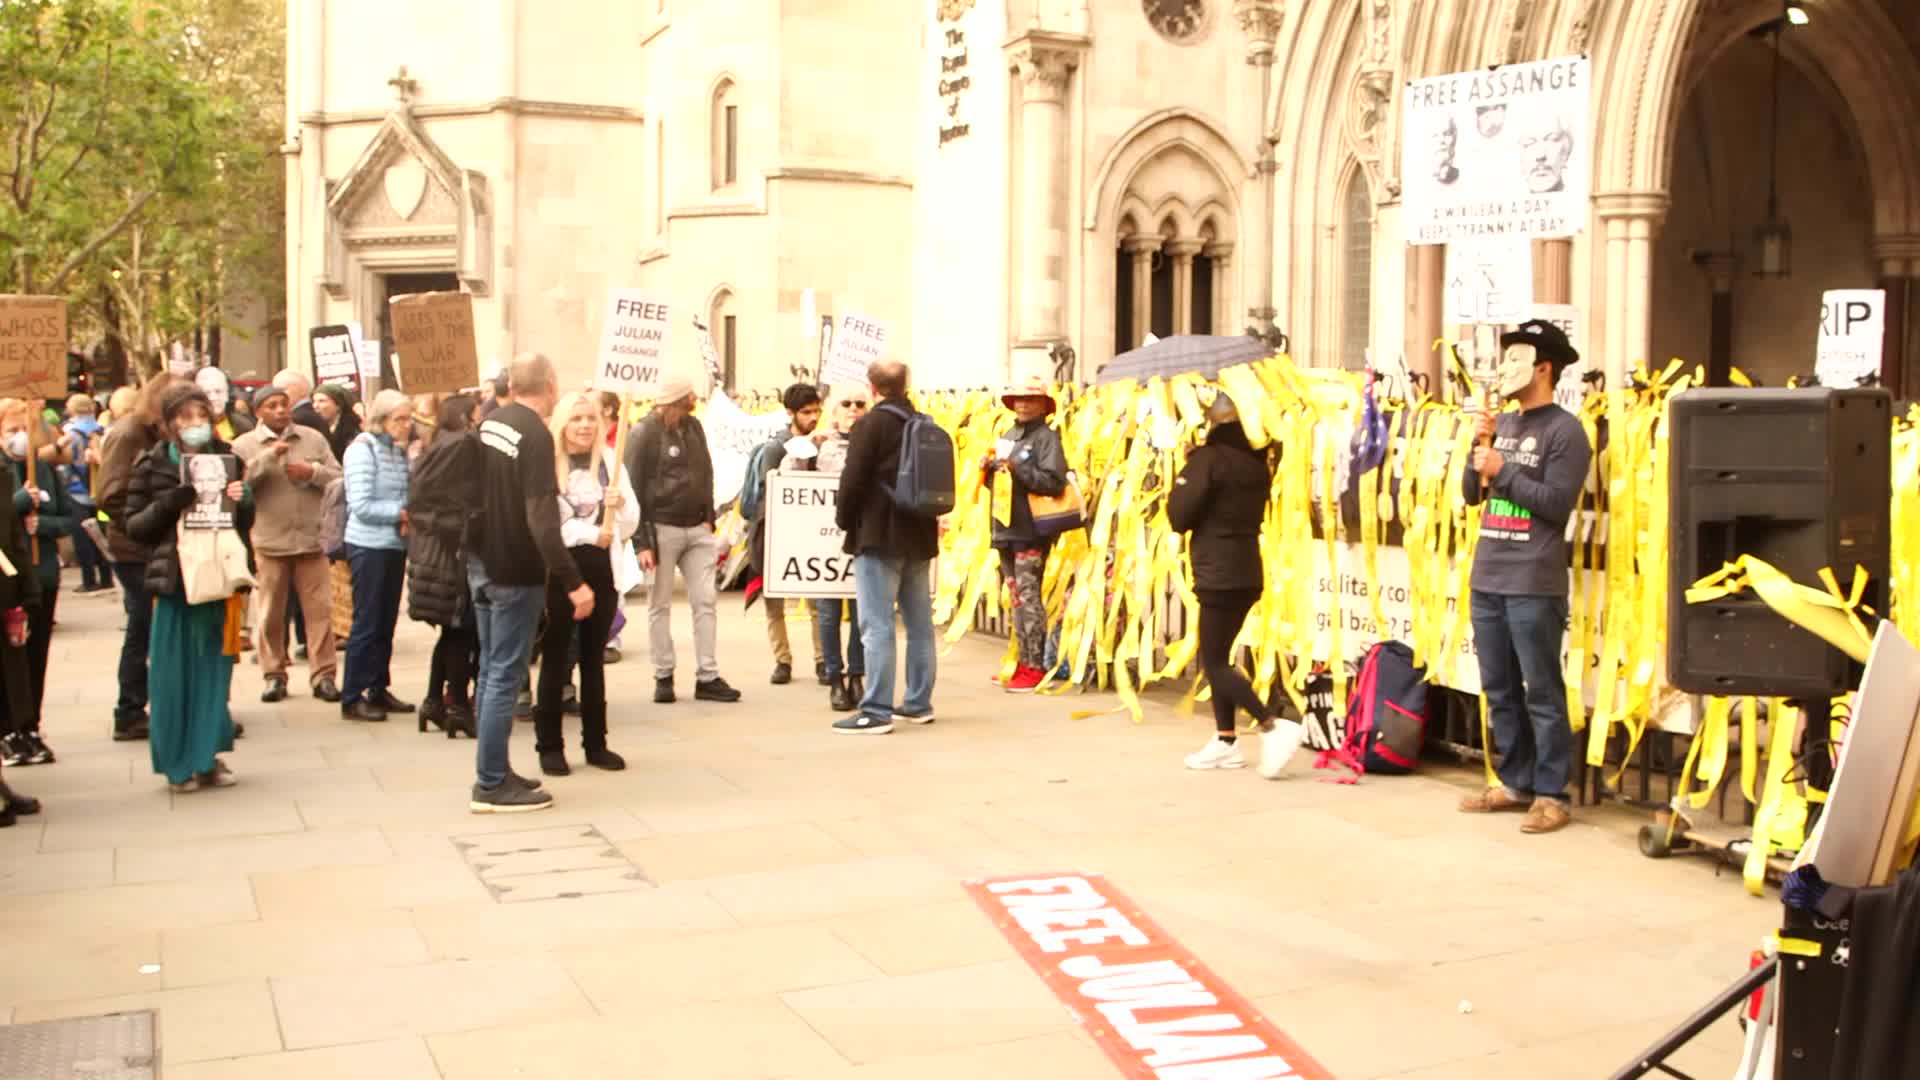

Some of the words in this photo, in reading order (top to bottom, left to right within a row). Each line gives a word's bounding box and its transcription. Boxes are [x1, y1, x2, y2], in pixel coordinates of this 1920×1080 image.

[1412, 79, 1458, 110] FREE
[1468, 61, 1579, 103] ASSANGE
[1524, 199, 1552, 214] DAY
[1539, 216, 1566, 232] BAY
[615, 299, 669, 322] FREE
[615, 325, 662, 342] JULIAN
[843, 315, 887, 342] FREE
[611, 344, 660, 358] ASSANGE
[604, 361, 660, 384] NOW!
[985, 874, 1150, 953] FREE
